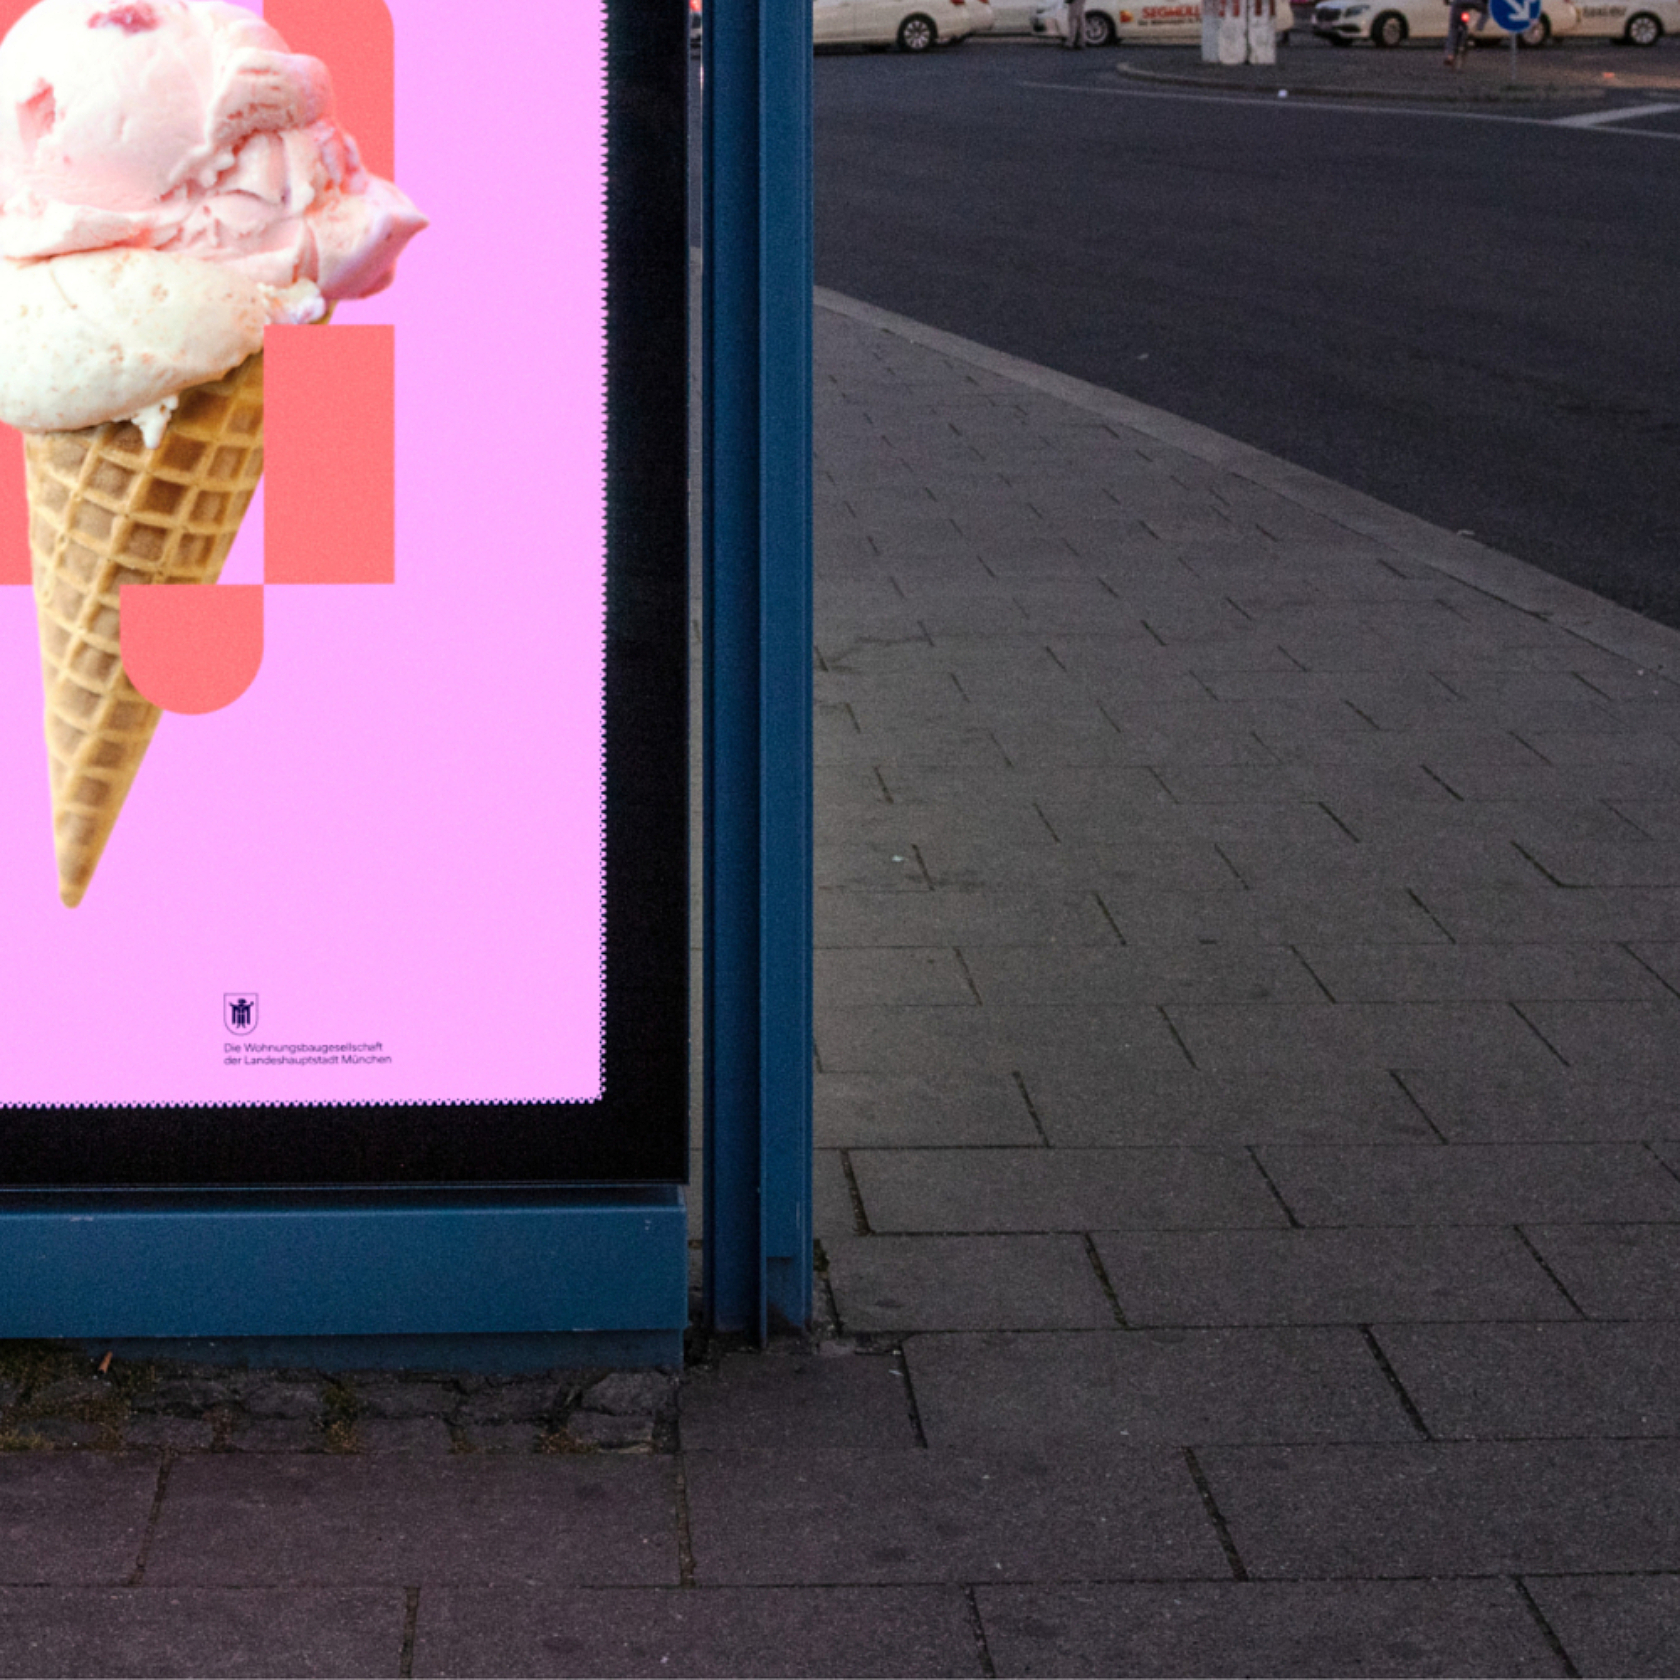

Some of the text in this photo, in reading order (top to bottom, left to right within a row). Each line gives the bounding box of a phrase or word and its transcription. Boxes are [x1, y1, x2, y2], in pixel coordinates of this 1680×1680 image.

[223, 1041, 384, 1056] Die Wohnungsbaugesellschaft
[223, 1053, 393, 1067] der Landeshauptstadt München
